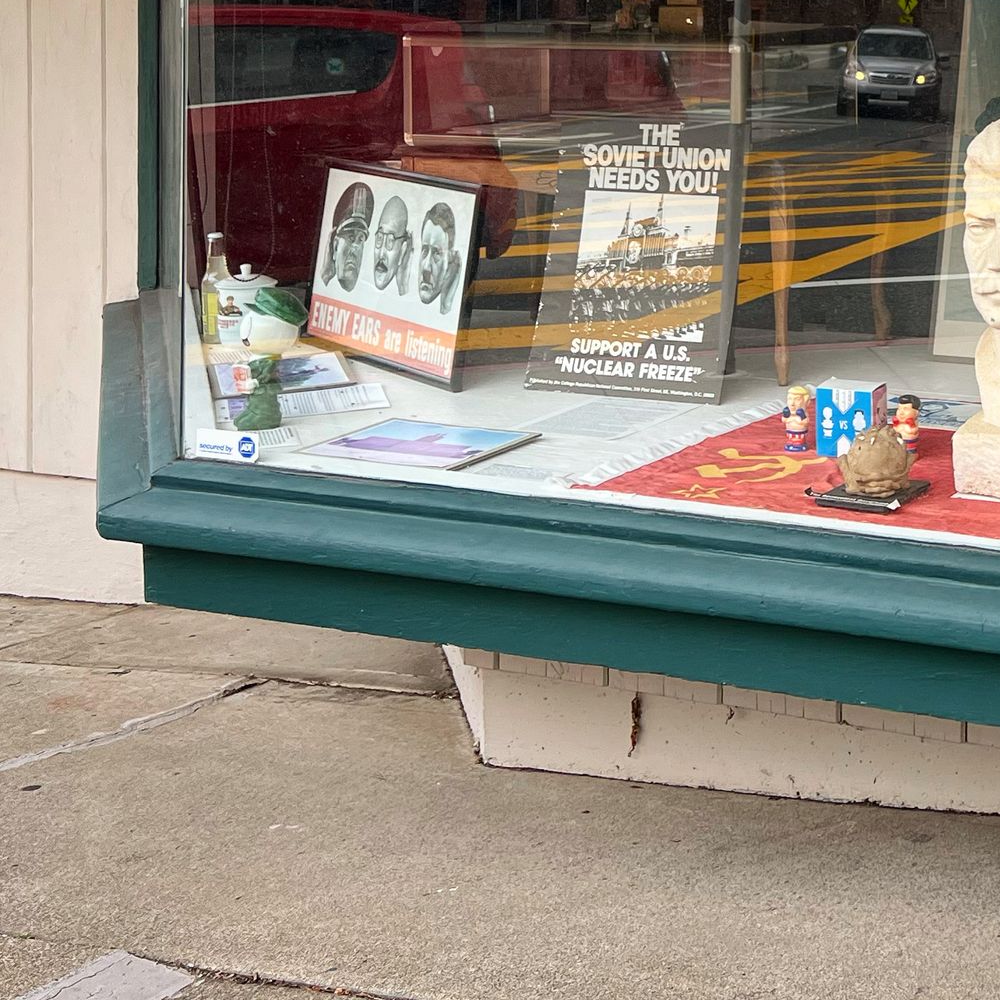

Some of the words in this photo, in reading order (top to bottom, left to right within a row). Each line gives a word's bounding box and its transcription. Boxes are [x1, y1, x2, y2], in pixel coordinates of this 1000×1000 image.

[639, 123, 681, 146] THE
[582, 144, 660, 169] SOVIET
[662, 146, 731, 171] UNION
[589, 168, 660, 192] NEEDS
[667, 170, 719, 194] YOU!
[311, 301, 351, 336] ENEMY
[351, 312, 382, 347] EARS
[384, 328, 402, 353] are
[404, 329, 453, 375] listening
[570, 338, 640, 359] SUPPORT
[645, 342, 658, 359] A
[662, 344, 691, 362] U.S.
[554, 357, 635, 378] "NUCLEAR
[639, 362, 701, 383] FREEZE"
[839, 420, 848, 430] VS
[199, 443, 225, 451] secured
[225, 445, 233, 453] by
